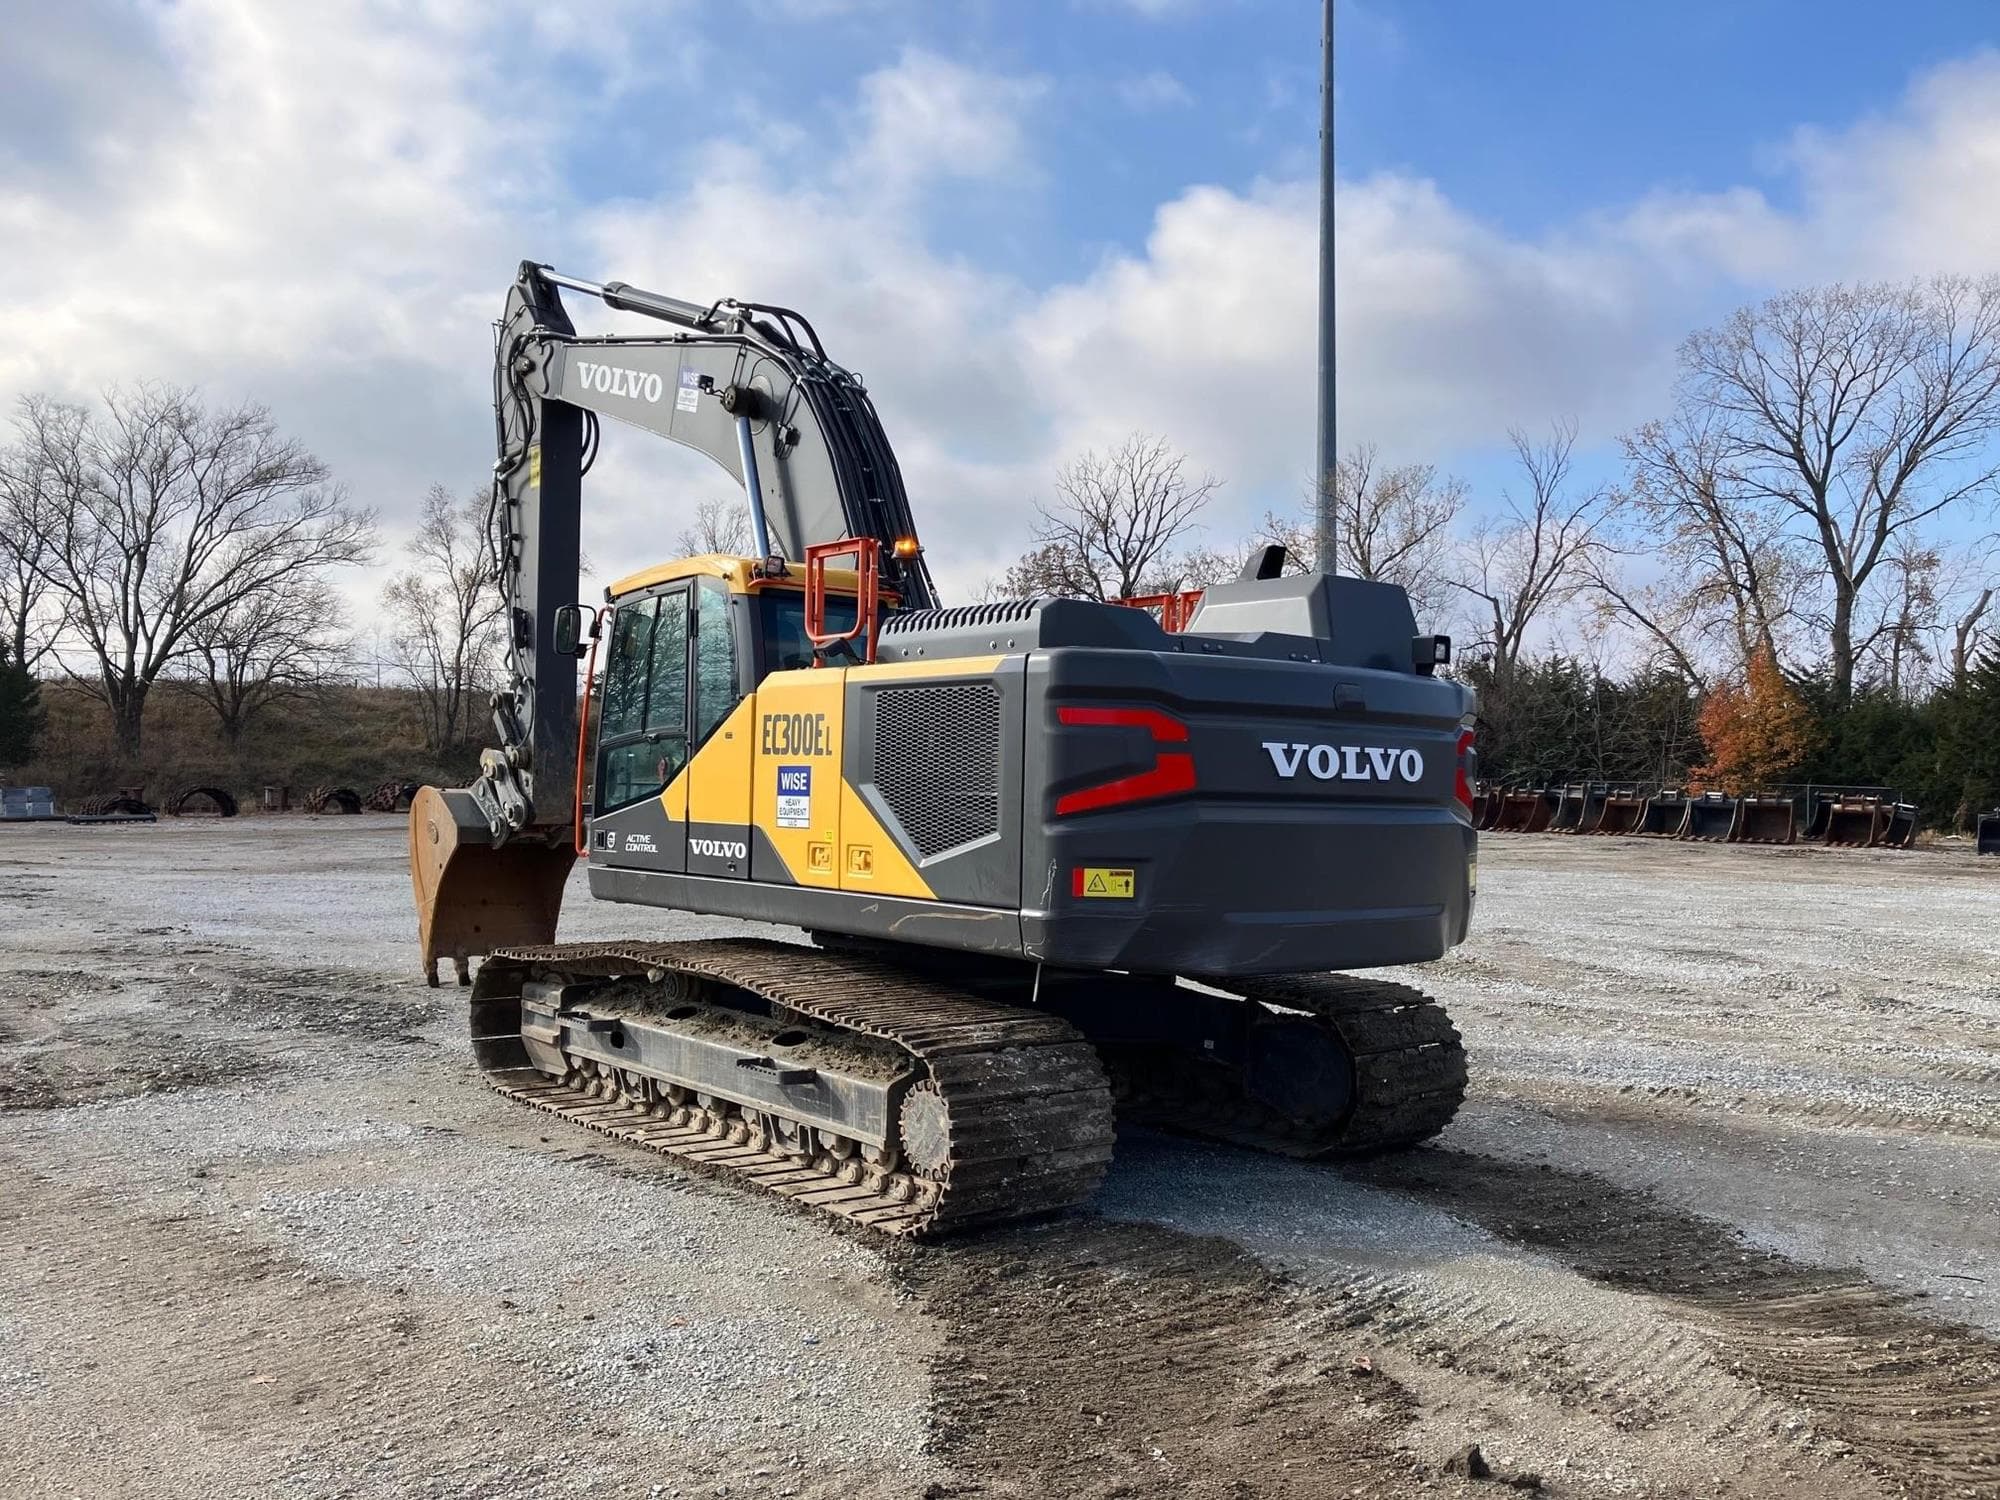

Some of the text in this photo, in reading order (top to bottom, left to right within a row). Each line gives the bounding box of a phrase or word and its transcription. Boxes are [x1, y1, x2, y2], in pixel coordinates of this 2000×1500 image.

[577, 362, 662, 403] VOLVO
[1262, 742, 1424, 783] VOLVO
[780, 772, 807, 790] WISE
[785, 798, 801, 806] HEAVY
[779, 807, 806, 816] EQUIPMENT
[626, 834, 652, 843] ACTIVE
[625, 843, 659, 853] CONTROL
[689, 838, 747, 859] VOLVO
